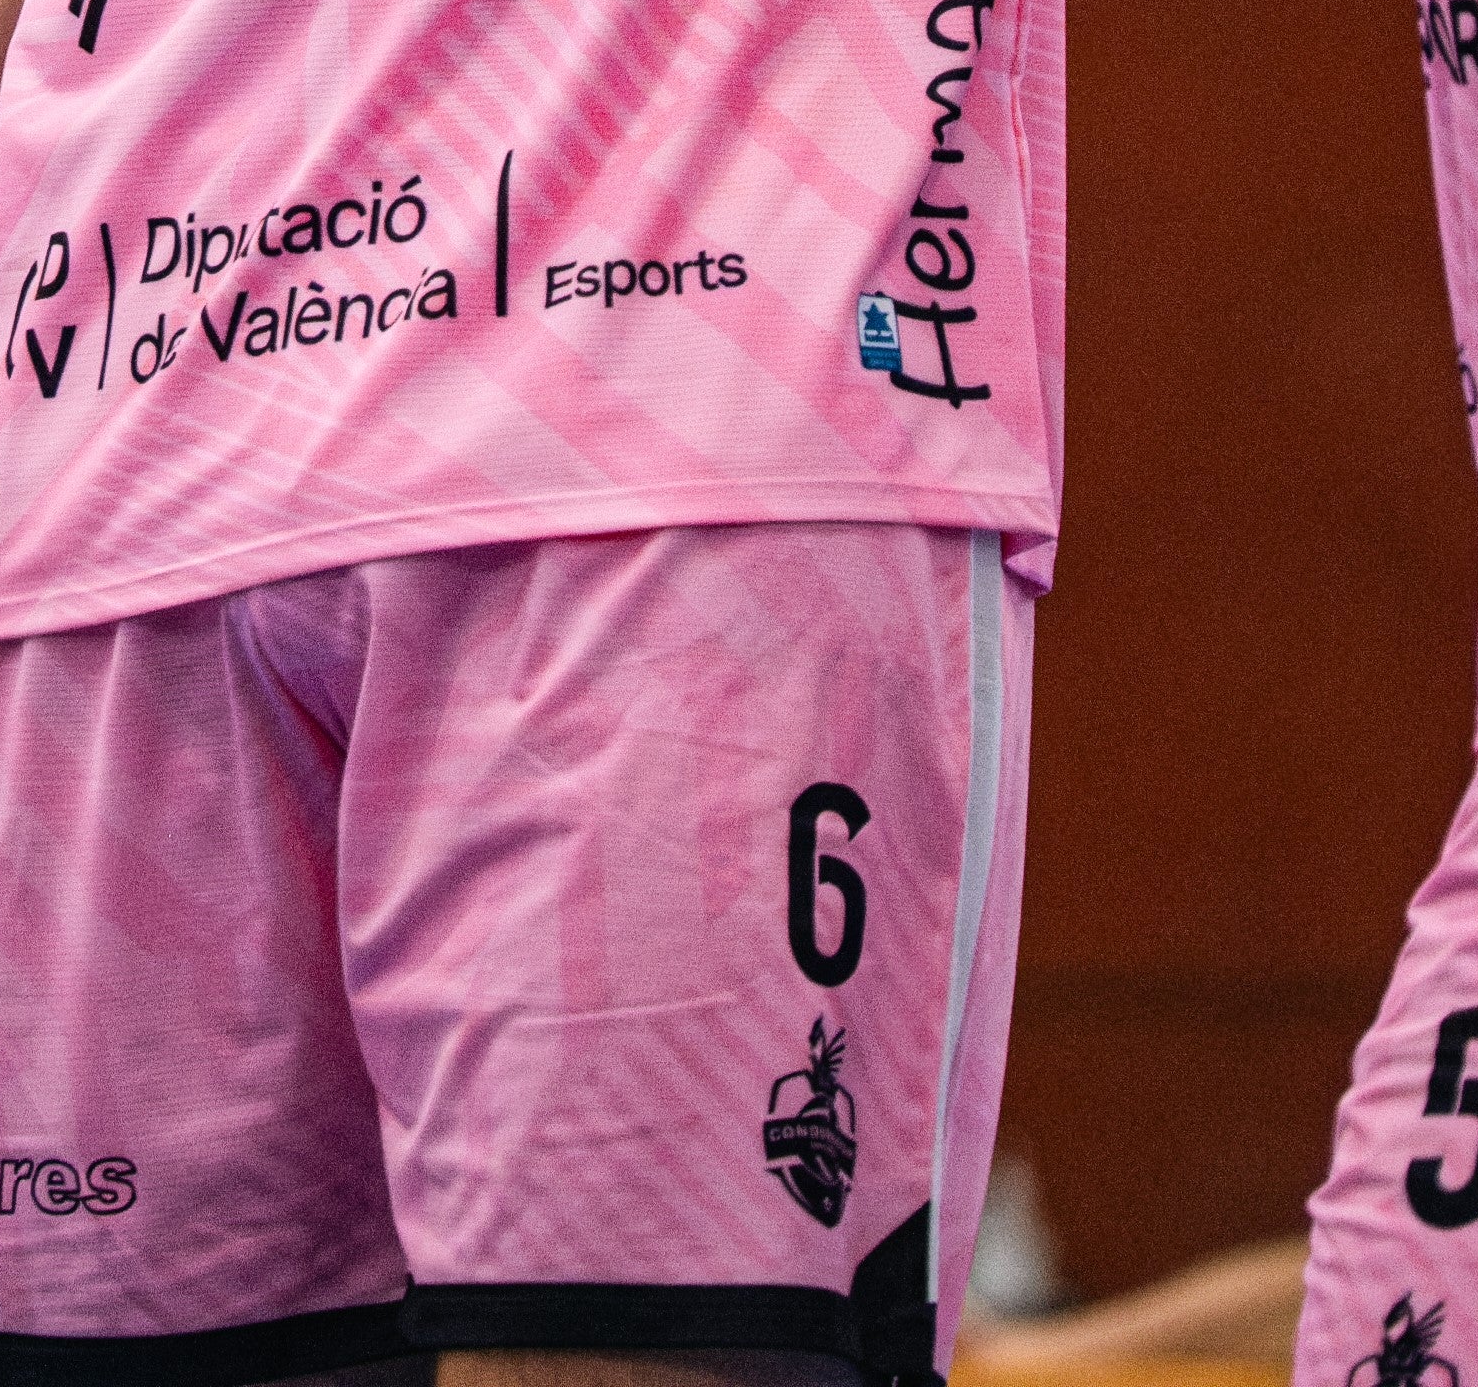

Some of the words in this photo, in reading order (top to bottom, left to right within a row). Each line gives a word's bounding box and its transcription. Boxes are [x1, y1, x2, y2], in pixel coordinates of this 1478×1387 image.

[200, 265, 459, 363] València
[544, 249, 748, 310] Esports
[787, 780, 872, 988] 6
